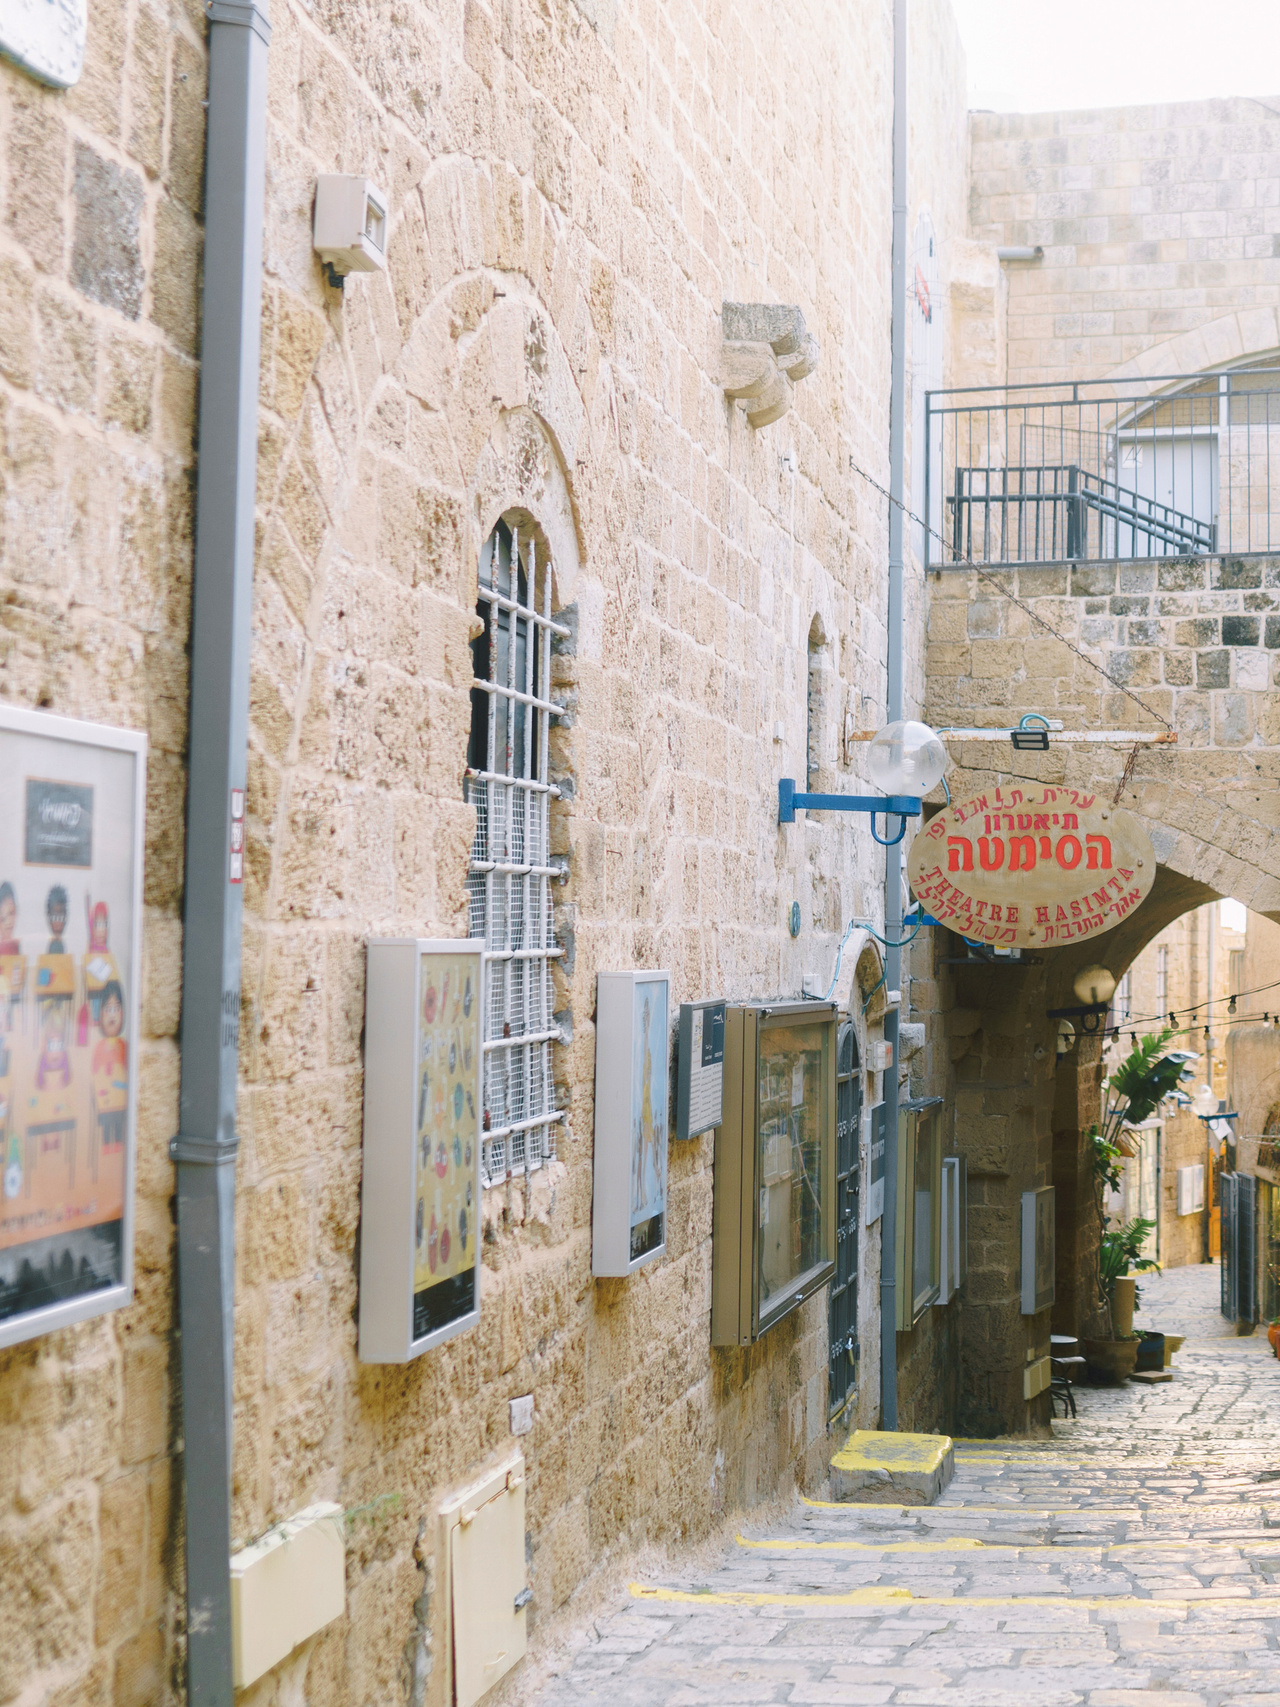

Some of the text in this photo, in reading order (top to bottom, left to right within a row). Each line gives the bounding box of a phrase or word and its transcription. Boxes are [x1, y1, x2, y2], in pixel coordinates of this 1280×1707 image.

[925, 786, 1096, 841] עריית תל אביב יפו
[983, 813, 1079, 834] תיאטרון
[946, 833, 1113, 872] הסימטה
[912, 875, 1142, 943] אגף התרבות מנהל קהילה
[926, 865, 1134, 923] THEATRE HASIMTA
